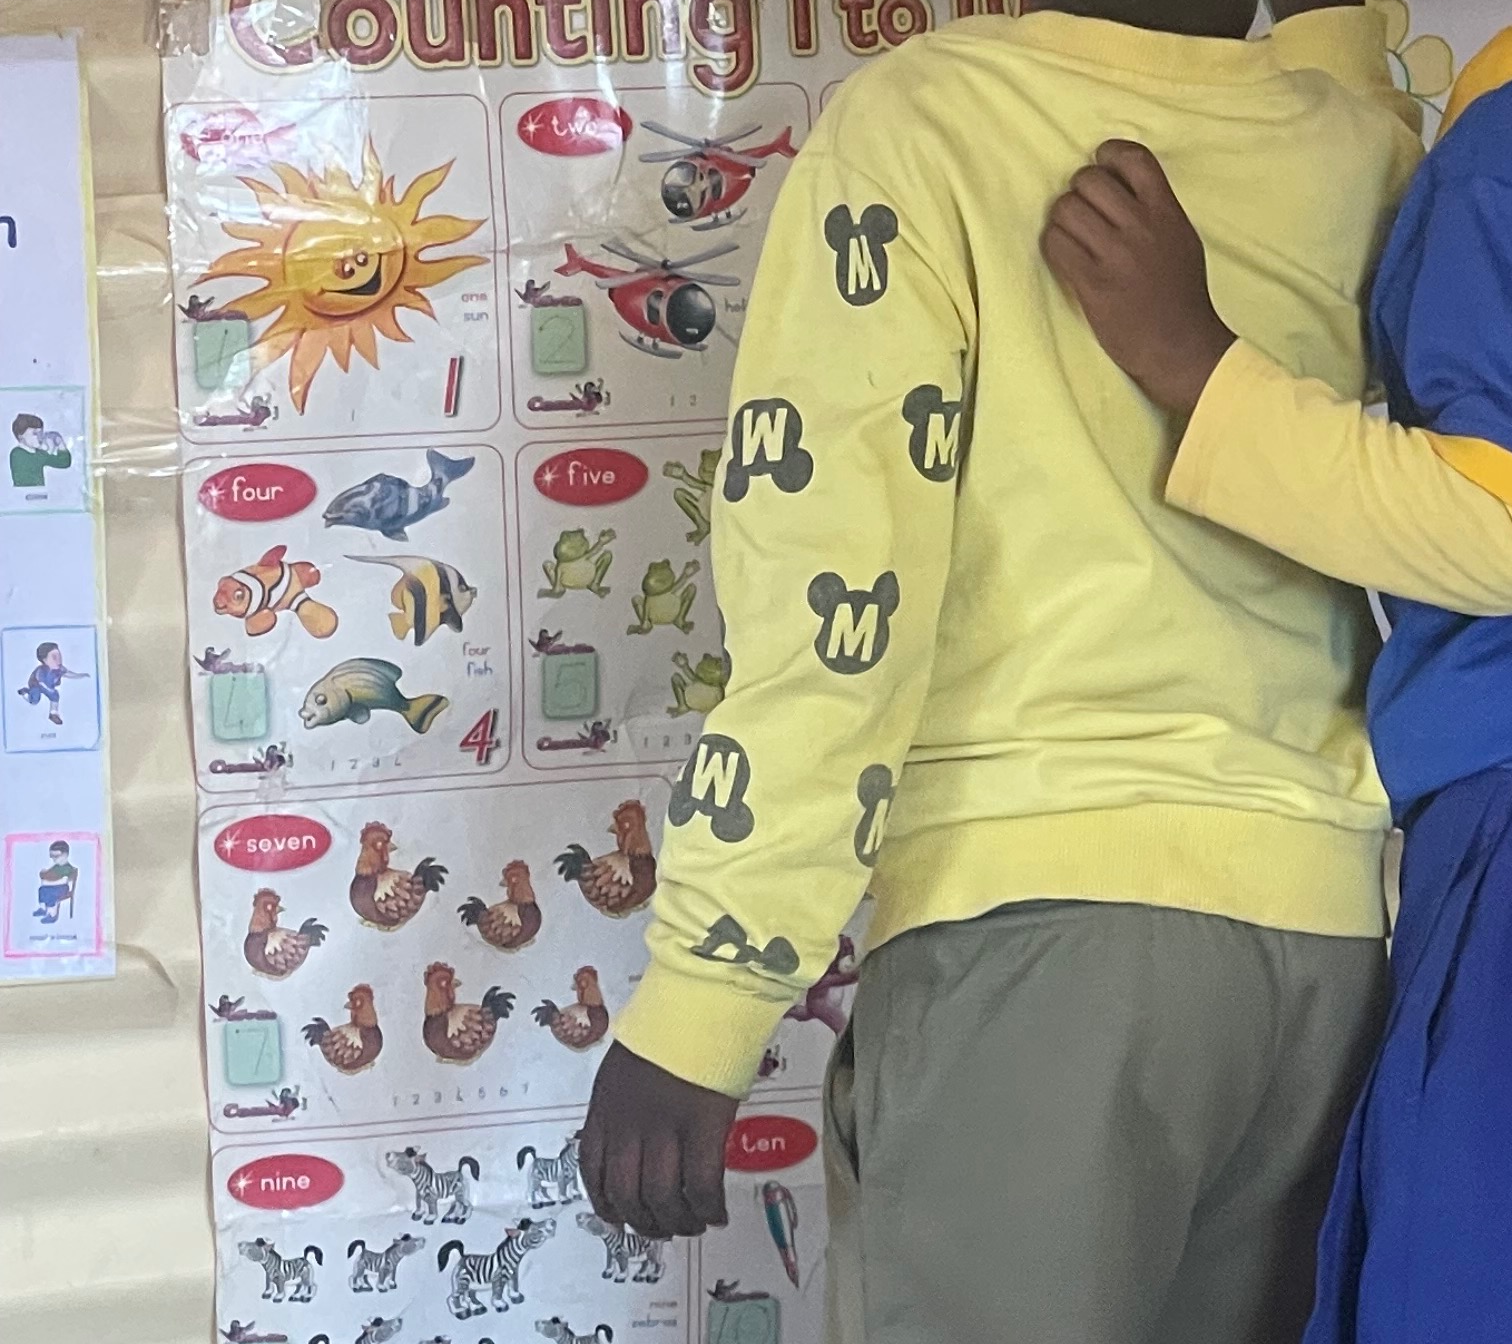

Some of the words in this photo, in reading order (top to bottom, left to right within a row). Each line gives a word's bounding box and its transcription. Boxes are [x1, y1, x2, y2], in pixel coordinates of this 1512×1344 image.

[848, 234, 881, 294] M
[567, 463, 616, 486] five
[231, 479, 283, 502] four
[827, 602, 879, 663] M
[462, 641, 491, 656] four
[467, 661, 493, 676] fish
[458, 707, 497, 766] 4
[246, 833, 317, 852] seven
[741, 1132, 786, 1154] ten
[259, 1172, 310, 1193] nine
